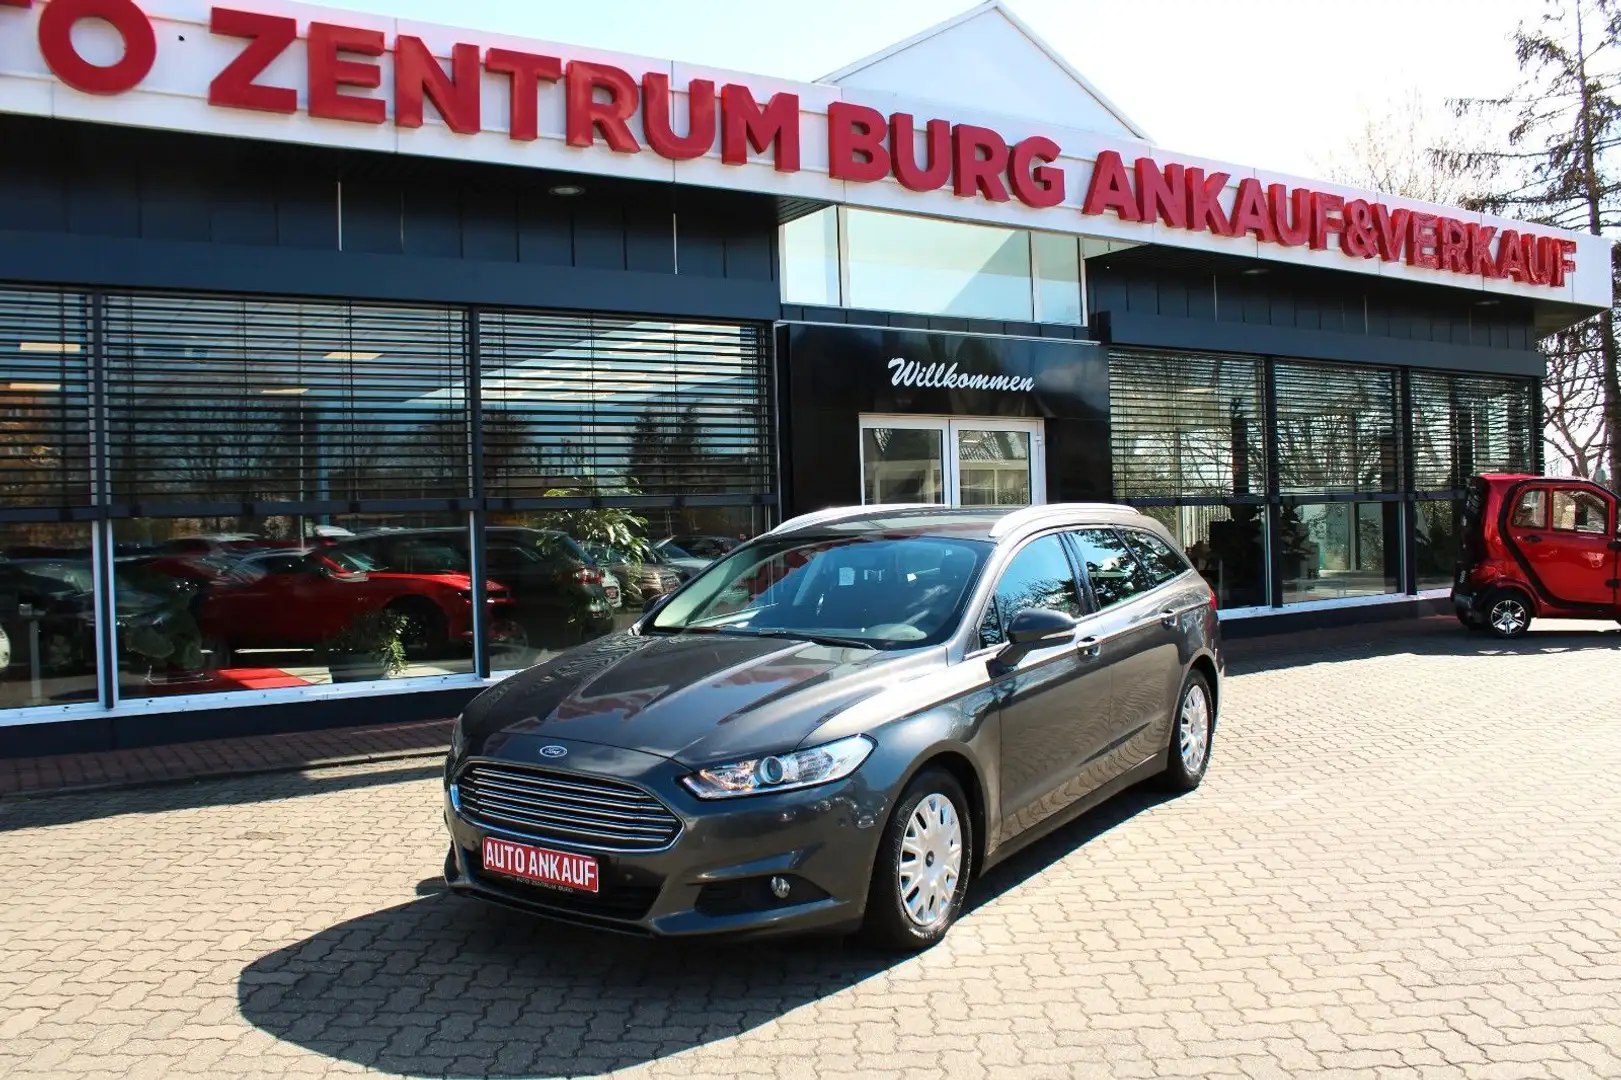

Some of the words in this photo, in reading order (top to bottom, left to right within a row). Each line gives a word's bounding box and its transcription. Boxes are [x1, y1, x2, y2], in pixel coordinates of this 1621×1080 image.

[207, 6, 800, 173] ZENTRUM
[827, 100, 1066, 209] BURG
[1081, 149, 1578, 288] ANKAUF&VERKAUF
[887, 357, 1035, 392] Willkommen
[485, 841, 525, 874] AUTO
[528, 850, 596, 887] ANKAUF
